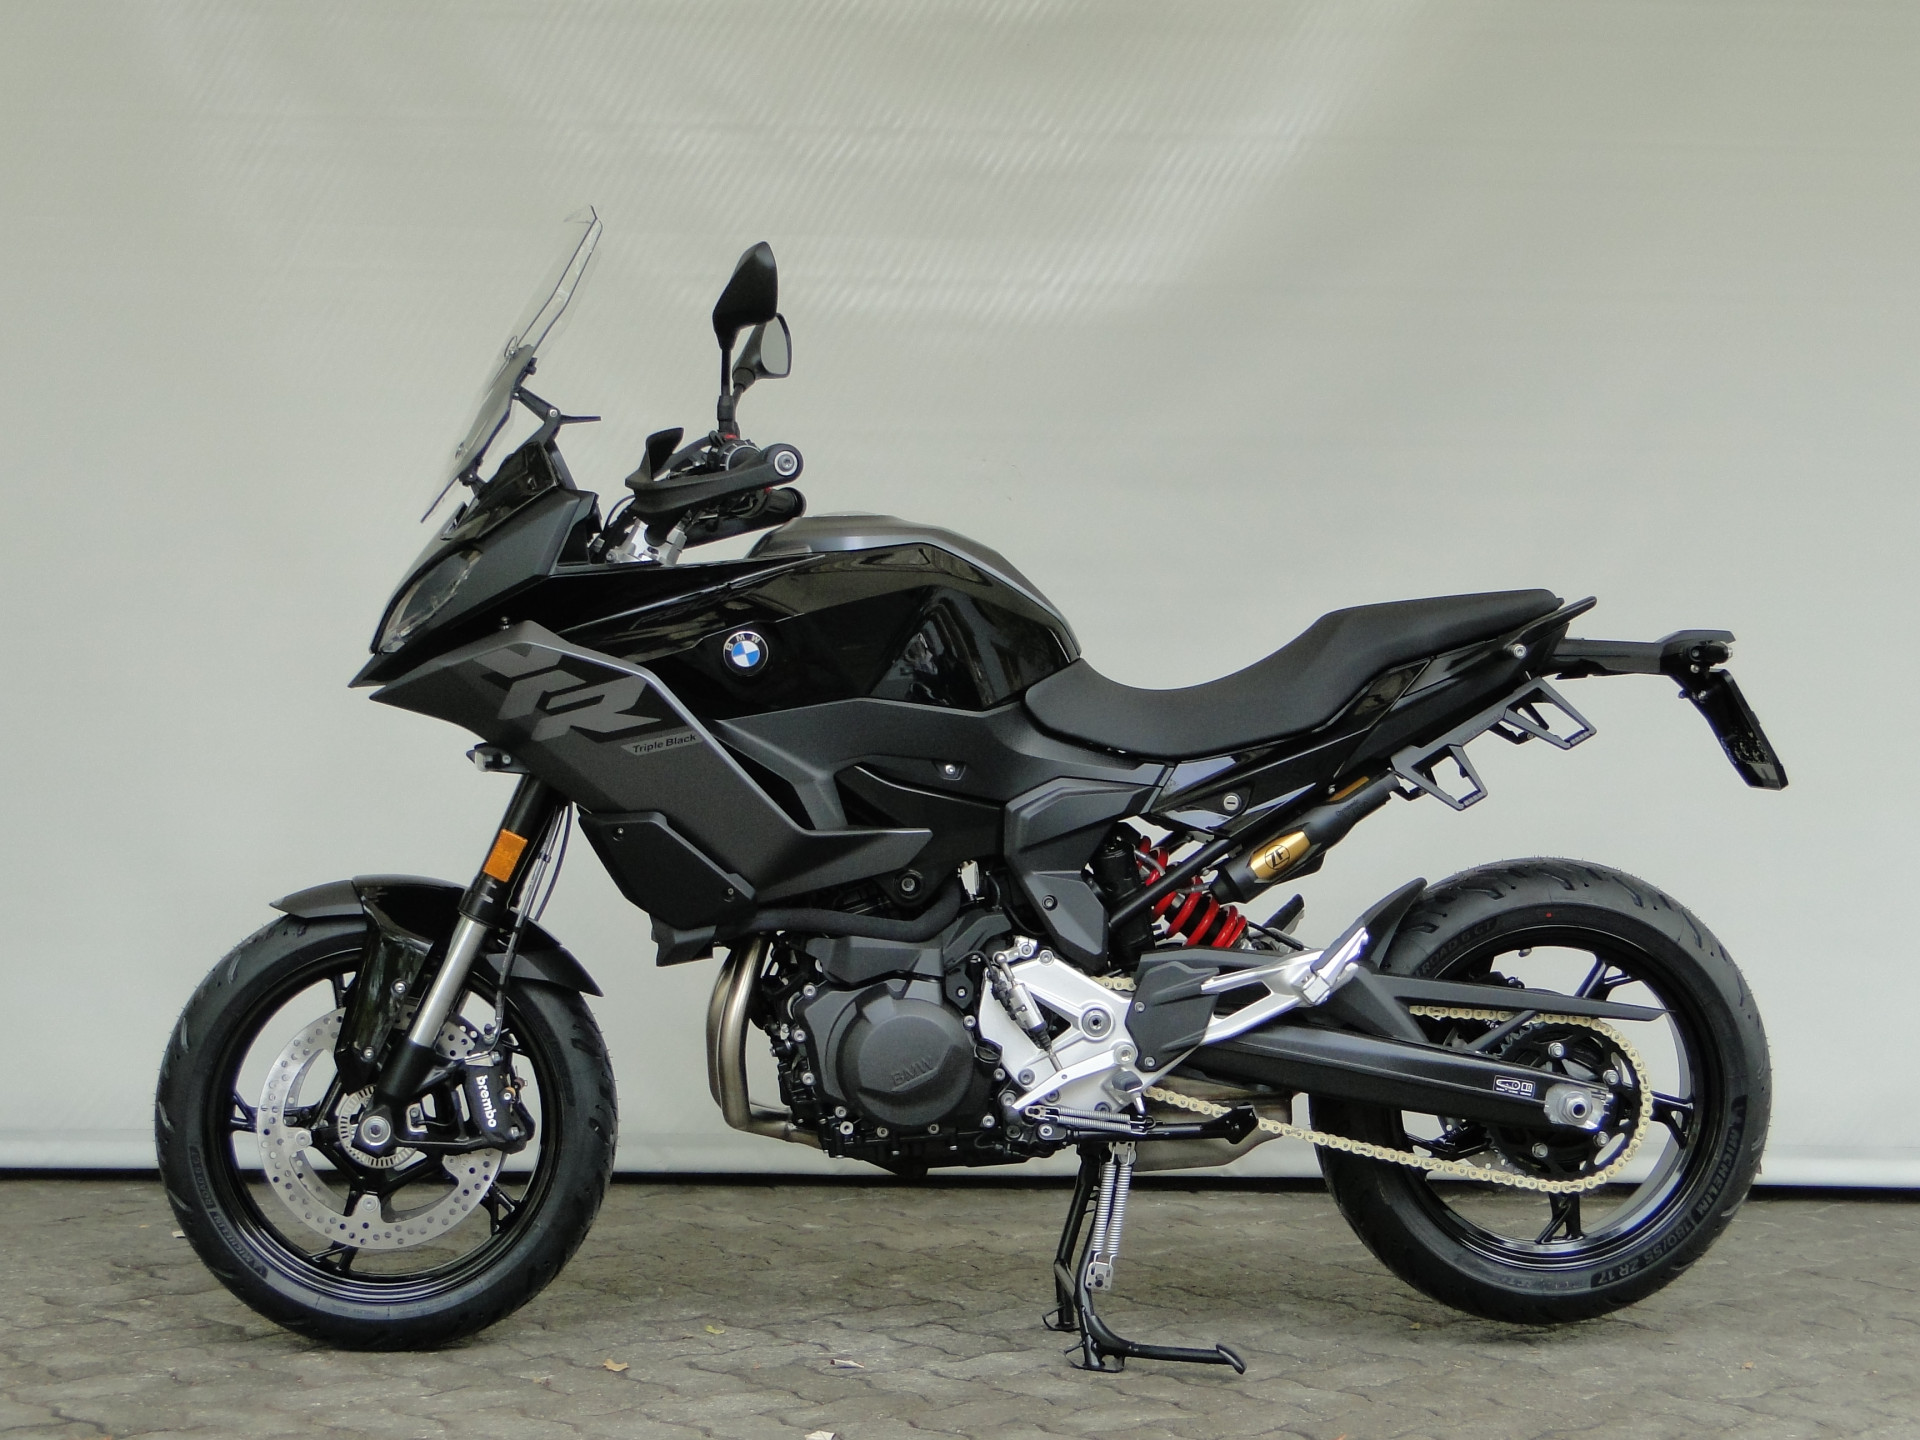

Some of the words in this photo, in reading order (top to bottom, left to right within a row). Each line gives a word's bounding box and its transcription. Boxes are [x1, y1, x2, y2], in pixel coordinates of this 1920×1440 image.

[633, 741, 663, 752] Triple
[666, 734, 696, 746] Black
[1265, 845, 1290, 869] ZF
[1421, 938, 1458, 975] ROAD
[891, 1056, 933, 1085] BMW
[476, 1075, 497, 1128] brembo
[1696, 1129, 1738, 1215] MICHELIN
[213, 1214, 253, 1262] MICHELIN
[1644, 1219, 1692, 1265] 180/55
[1598, 1271, 1615, 1284] 17
[1619, 1258, 1640, 1277] ZR
